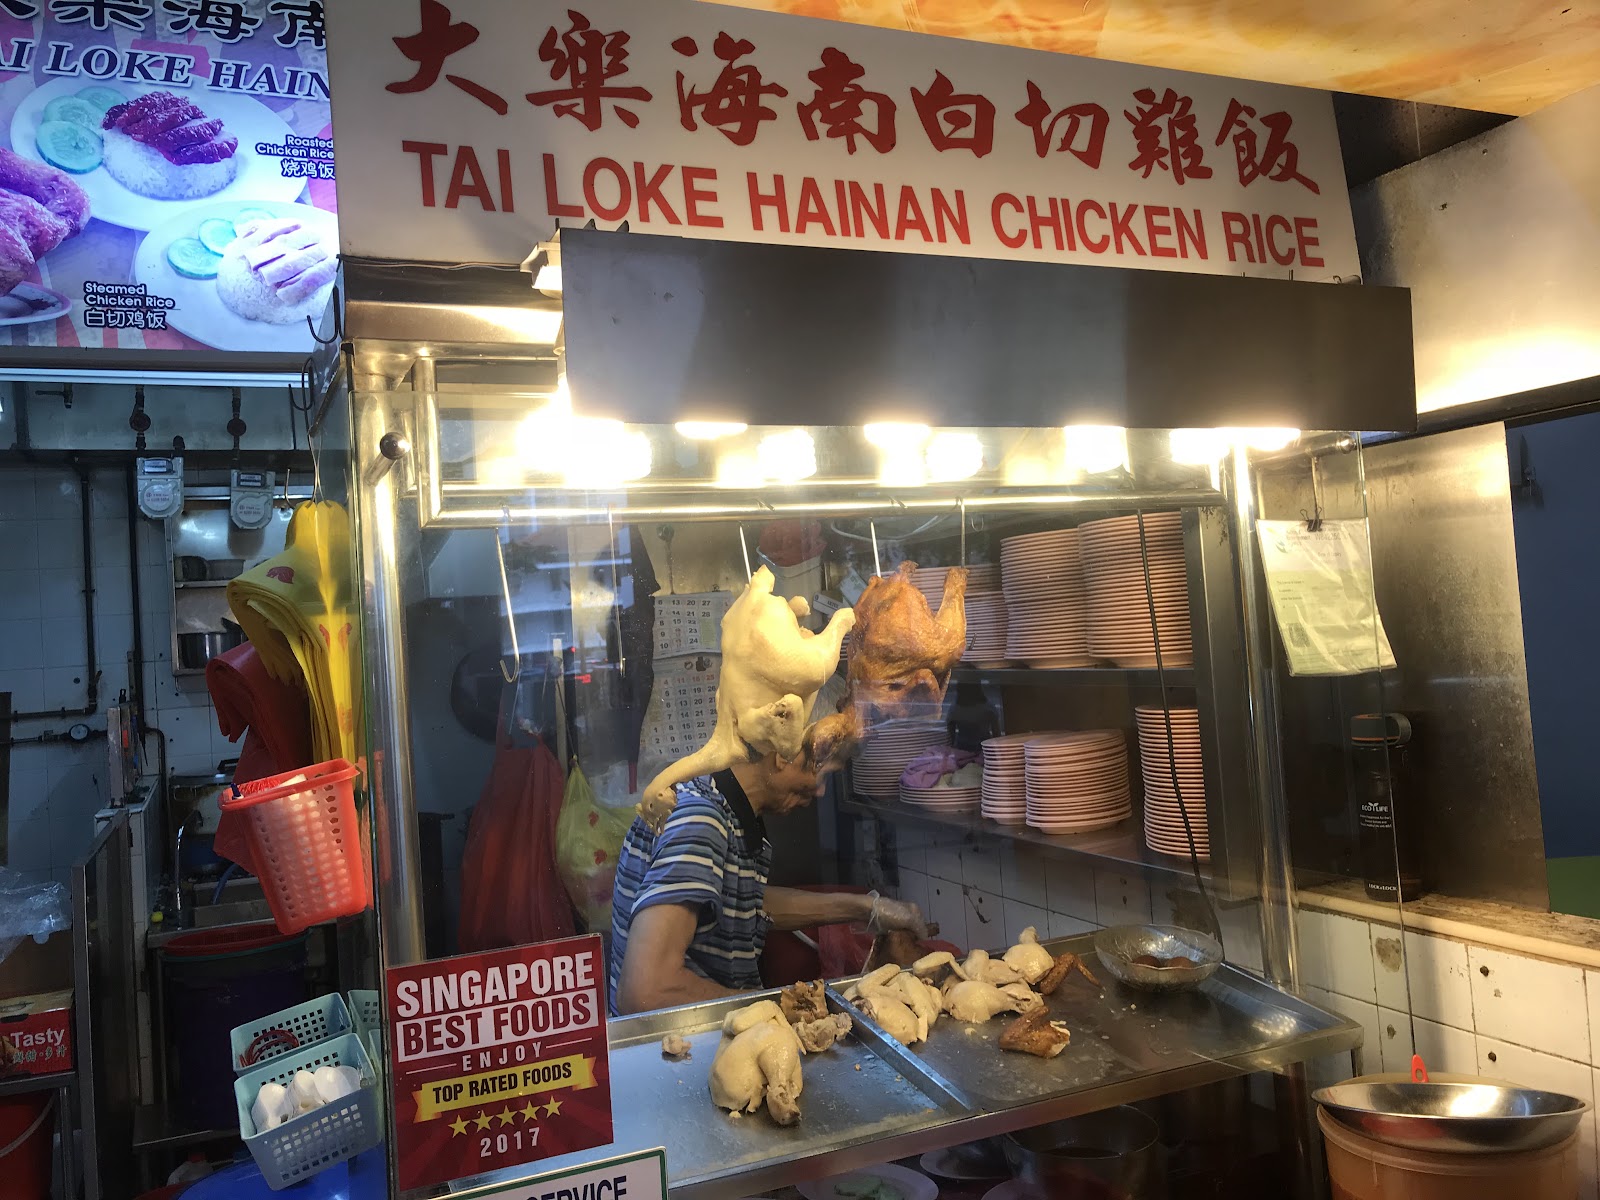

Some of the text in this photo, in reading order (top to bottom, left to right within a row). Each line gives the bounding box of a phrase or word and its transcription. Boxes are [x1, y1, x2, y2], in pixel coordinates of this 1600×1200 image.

[44, 42, 193, 85] LOKE
[385, 0, 1320, 195] 大樂海南白切雞飯
[256, 144, 334, 159] Chicken Rice
[286, 135, 333, 148] Roasted
[281, 159, 335, 179] 烧鸡饭
[402, 140, 1325, 267] TAI LOKE HAINAN CHICKEN RICE
[85, 282, 145, 295] Steamed
[85, 294, 174, 308] Chicken Rice
[86, 309, 166, 329] 白切鸡饭
[396, 951, 595, 1018] SINGAPORE
[10, 1028, 65, 1049] Tasty
[402, 993, 591, 1057] BEST FOODS
[462, 1041, 542, 1072] ENJOY
[433, 1062, 572, 1105] TOP RATED FOODS
[480, 1127, 540, 1158] 2017
[526, 1175, 627, 1200] VICE
